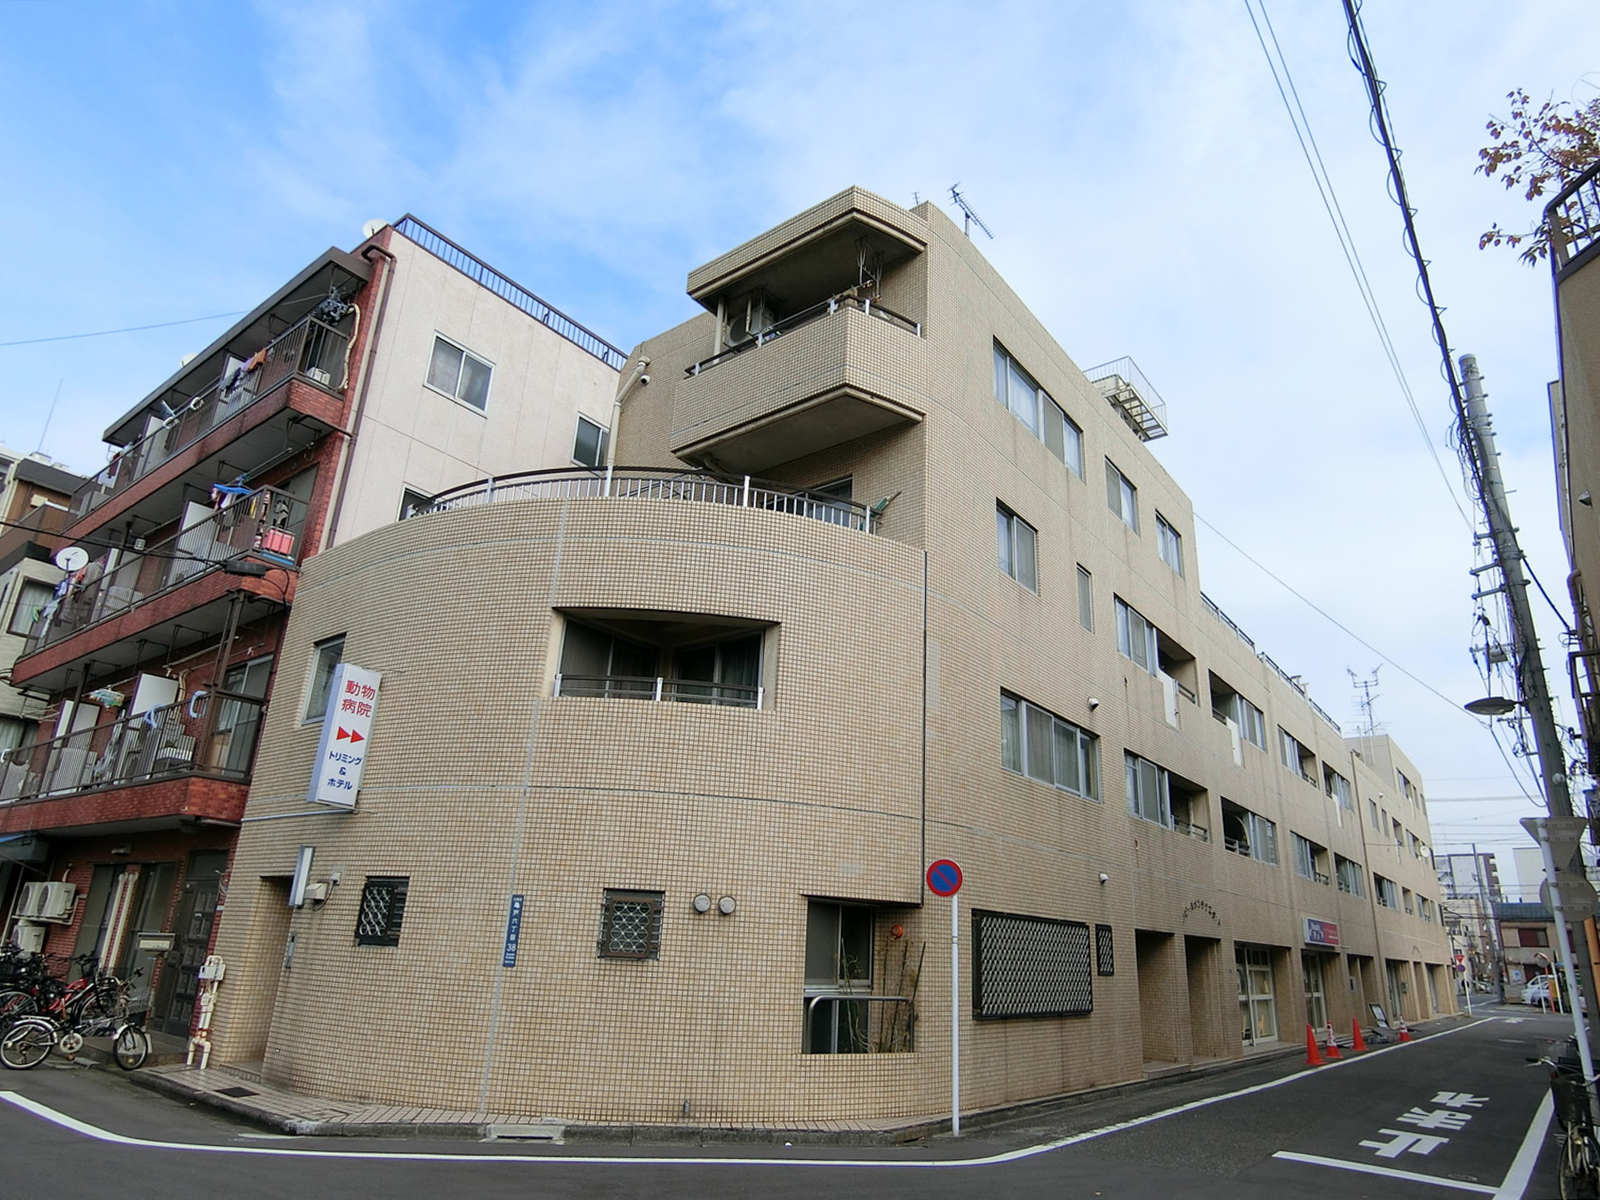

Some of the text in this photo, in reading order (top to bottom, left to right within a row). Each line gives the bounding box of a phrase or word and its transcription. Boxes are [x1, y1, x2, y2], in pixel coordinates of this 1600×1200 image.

[345, 680, 376, 700] 動物
[341, 699, 372, 717] 病院
[329, 751, 362, 765] トリミング
[339, 767, 346, 775] &
[327, 778, 353, 790] ホテル
